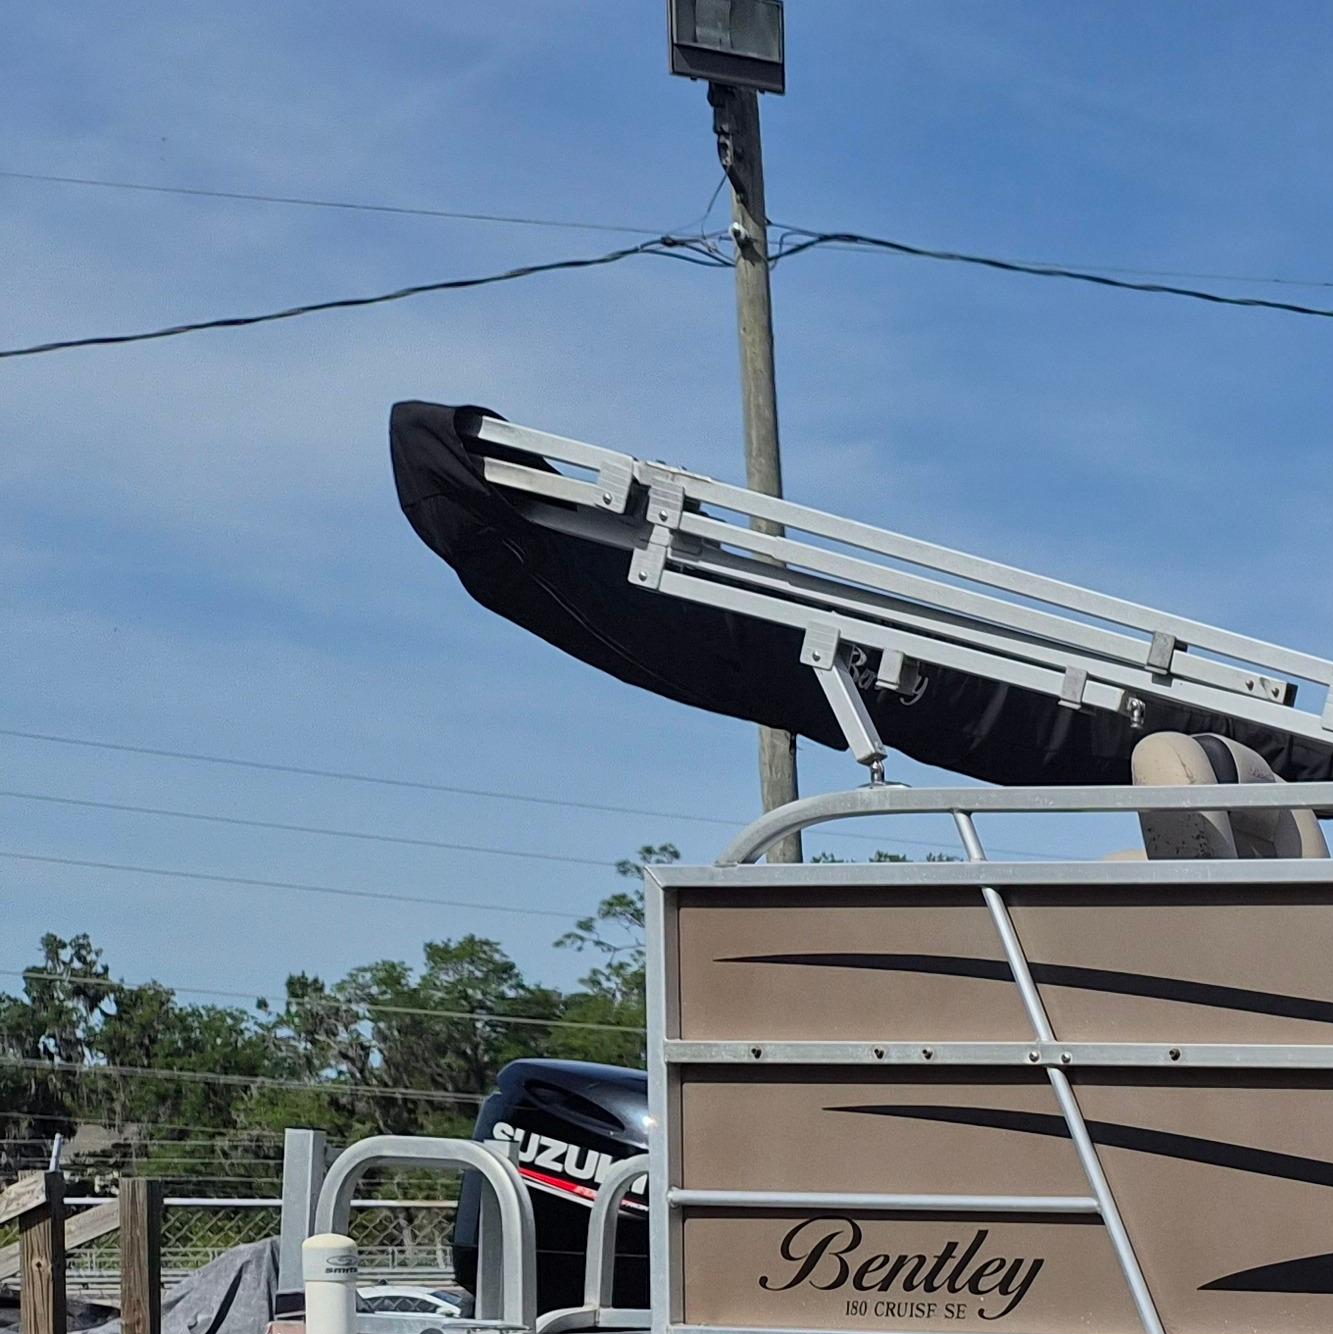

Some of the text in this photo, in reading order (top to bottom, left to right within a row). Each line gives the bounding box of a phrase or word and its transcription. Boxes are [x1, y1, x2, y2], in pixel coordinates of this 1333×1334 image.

[758, 1215, 1045, 1320] Bentley
[845, 1301, 867, 1317] 180
[943, 1303, 967, 1319] SE
